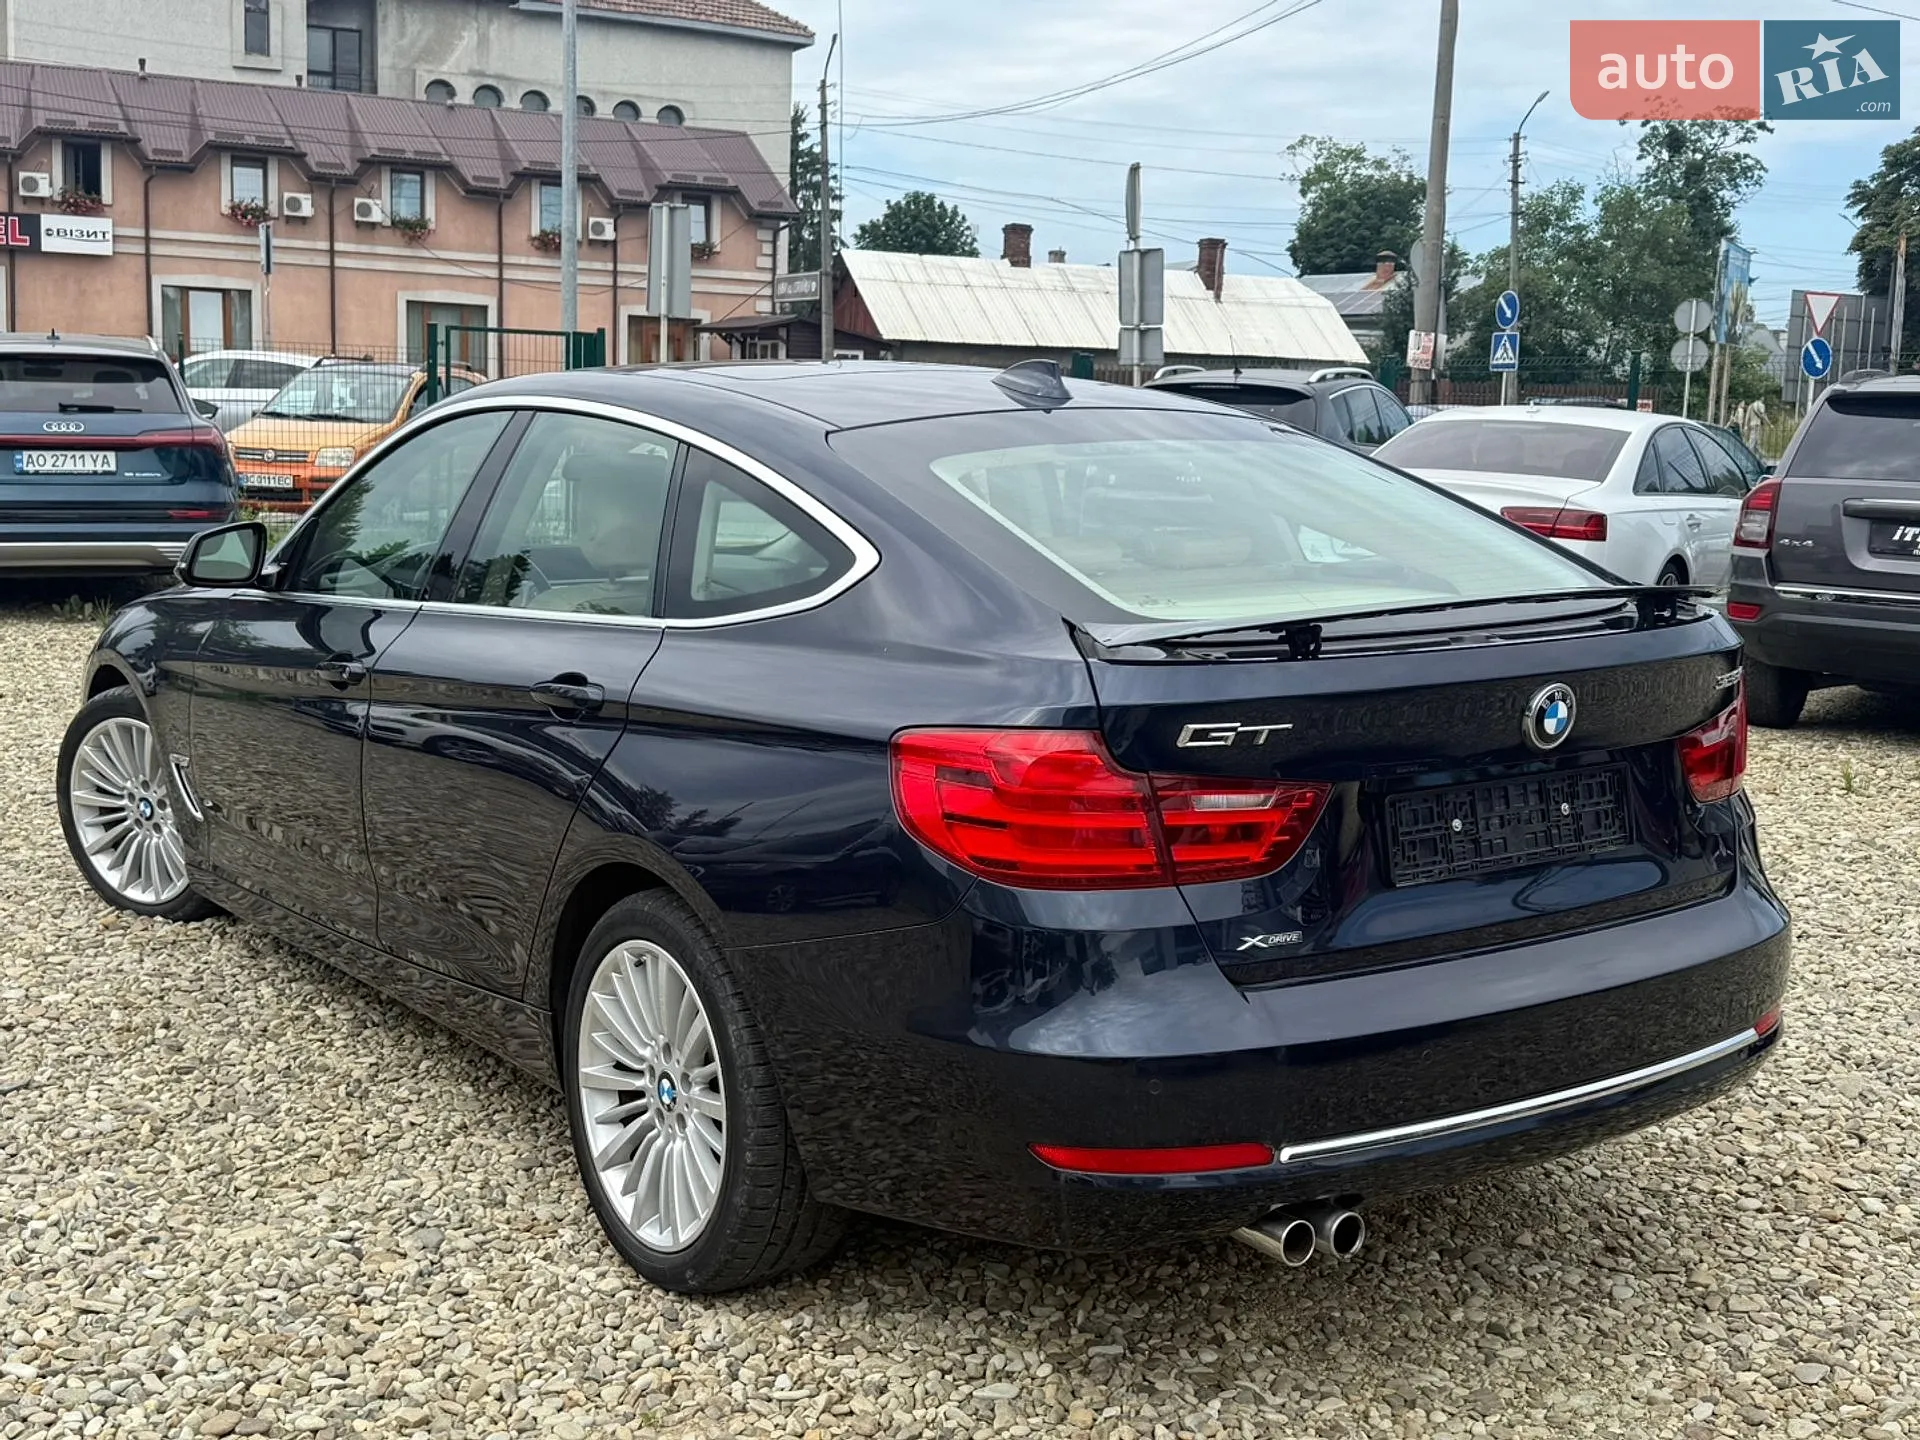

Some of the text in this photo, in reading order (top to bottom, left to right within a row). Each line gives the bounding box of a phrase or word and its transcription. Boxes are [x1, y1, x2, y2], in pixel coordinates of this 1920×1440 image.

[26, 454, 111, 469] AO 2711 YA
[1541, 690, 1572, 710] BMW
[1177, 722, 1293, 748] GT
